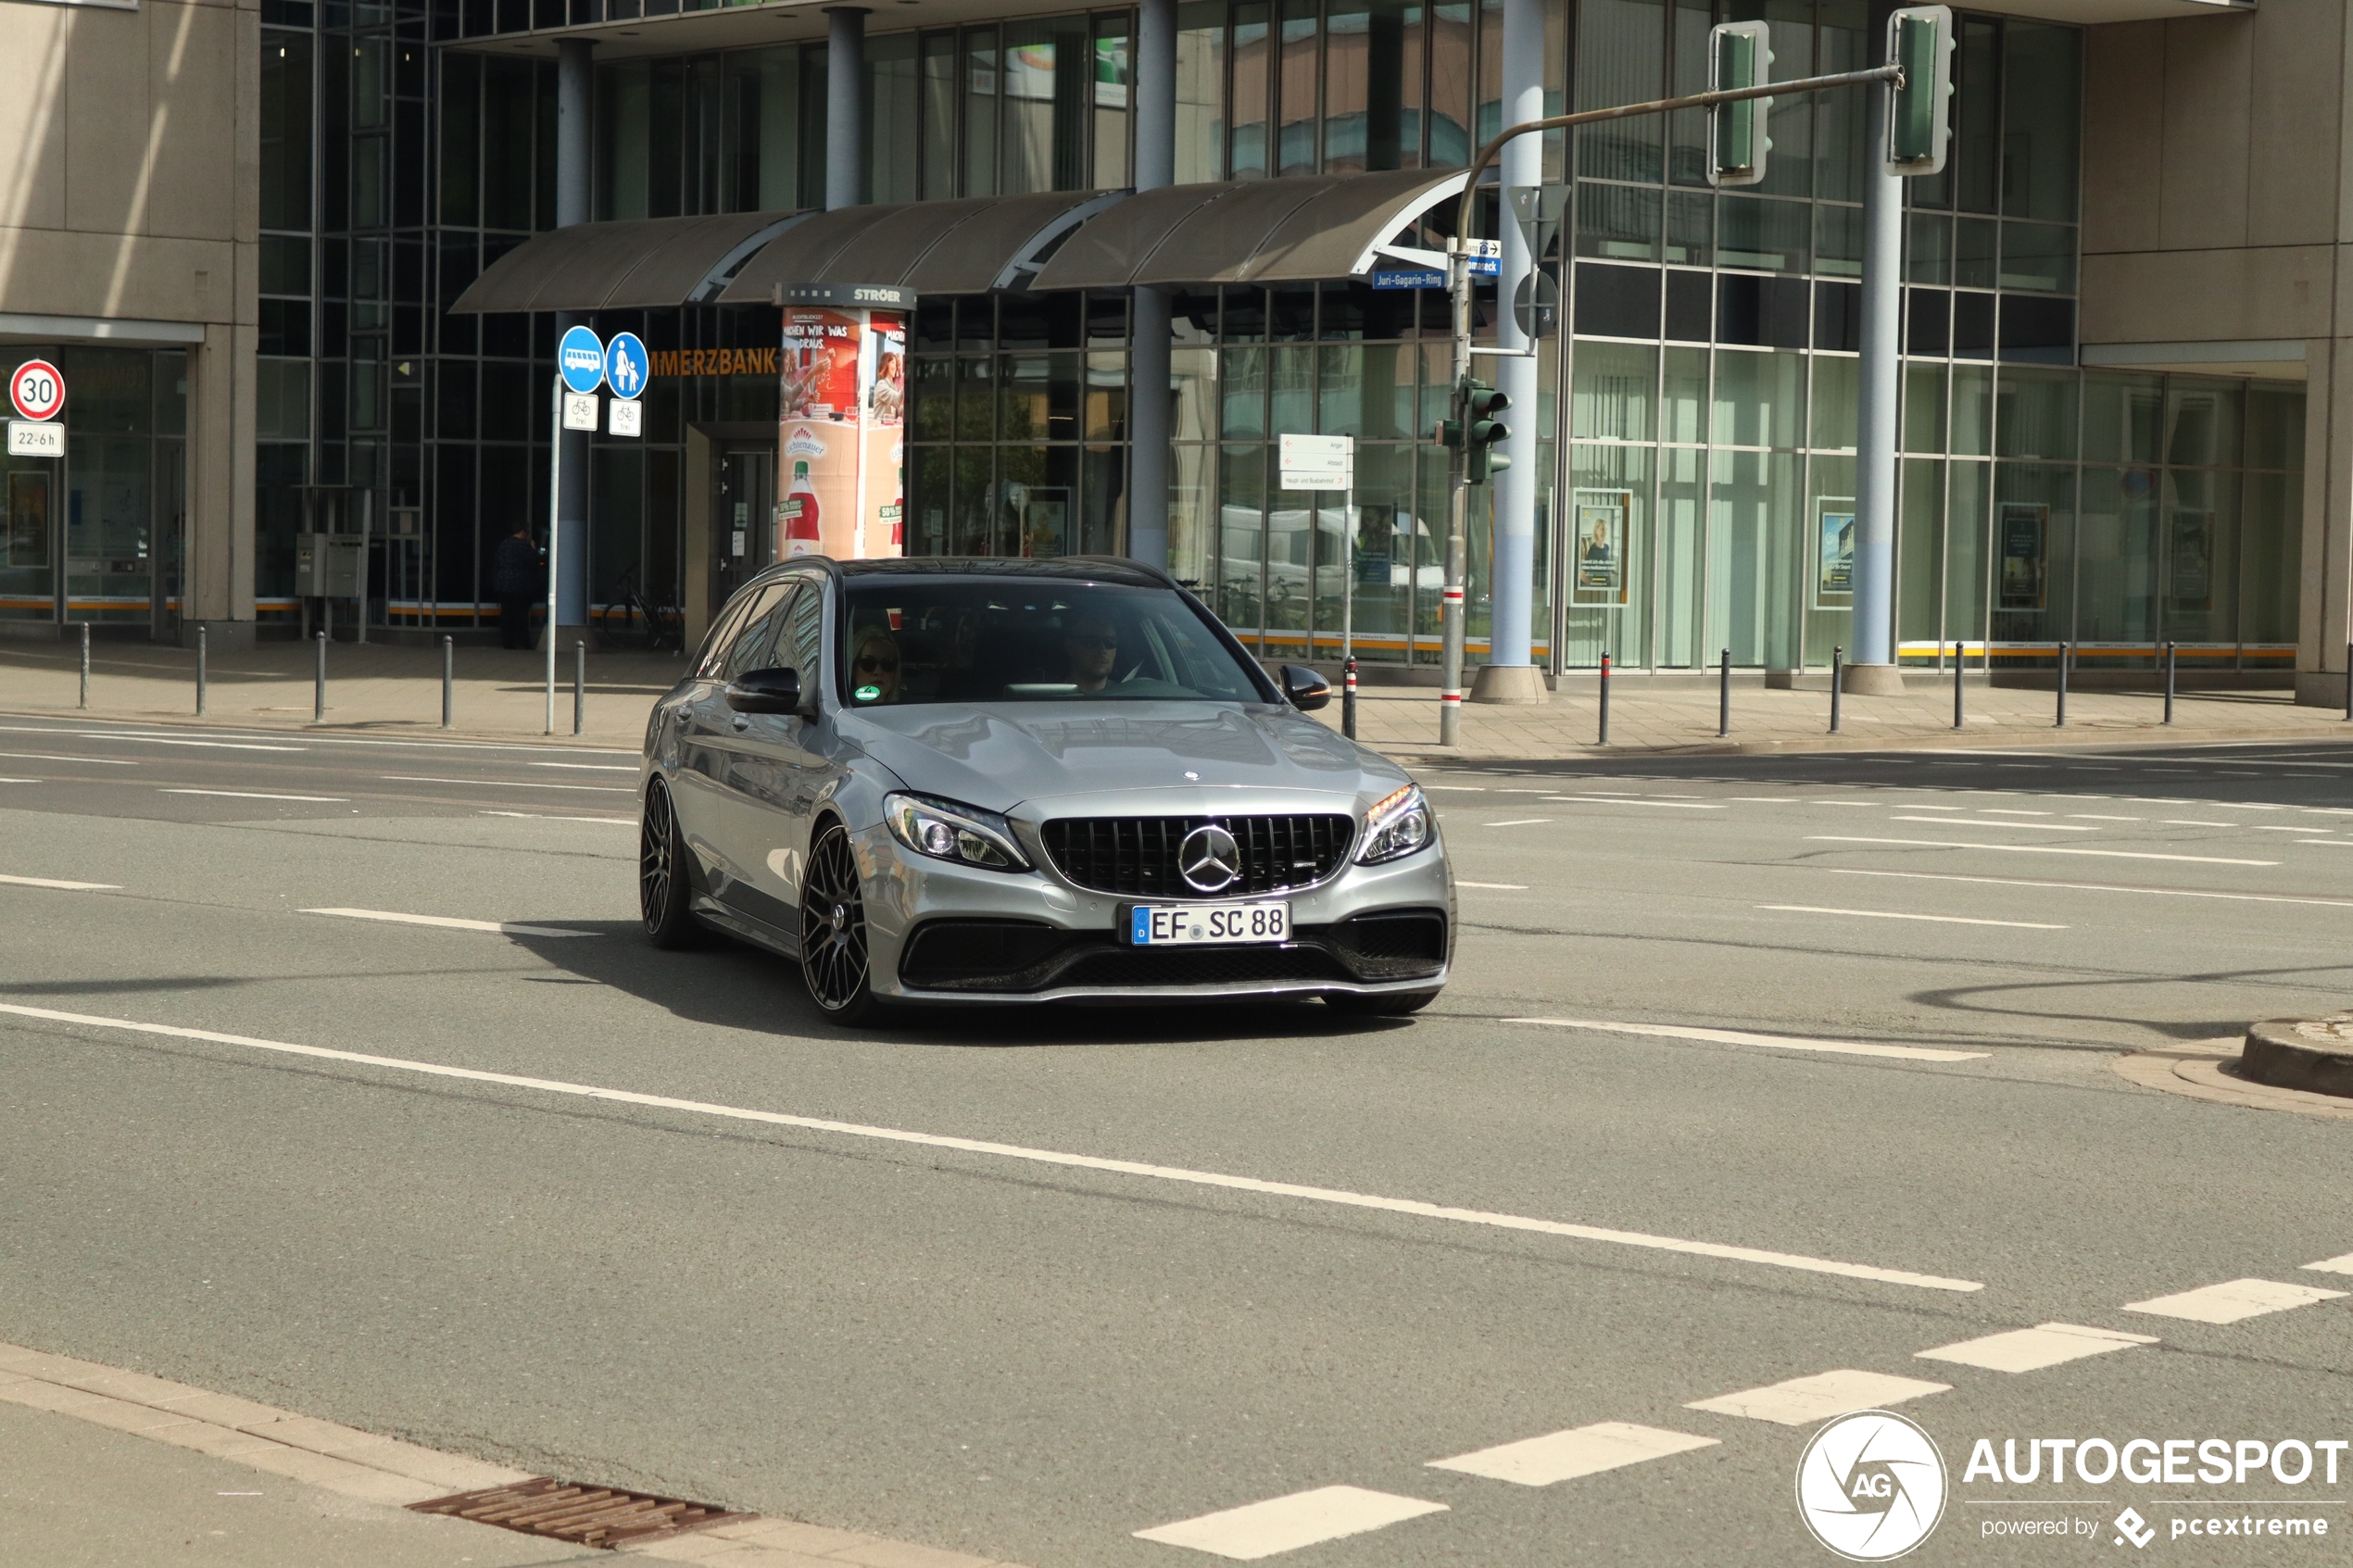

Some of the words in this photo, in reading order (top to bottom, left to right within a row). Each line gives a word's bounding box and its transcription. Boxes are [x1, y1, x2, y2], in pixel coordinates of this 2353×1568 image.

[1378, 272, 1442, 287] Juri-Gagarin-Ring
[854, 288, 900, 303] STRÖER
[808, 325, 824, 336] WIR
[827, 325, 848, 337] WAS
[799, 338, 825, 350] DRAUS.
[23, 378, 52, 403] 30
[575, 417, 586, 425] frei
[786, 440, 824, 455] Lichtenauer
[1139, 929, 1145, 937] D
[1152, 911, 1189, 939] EF
[1209, 910, 1243, 937] SC
[1252, 909, 1283, 936] 88
